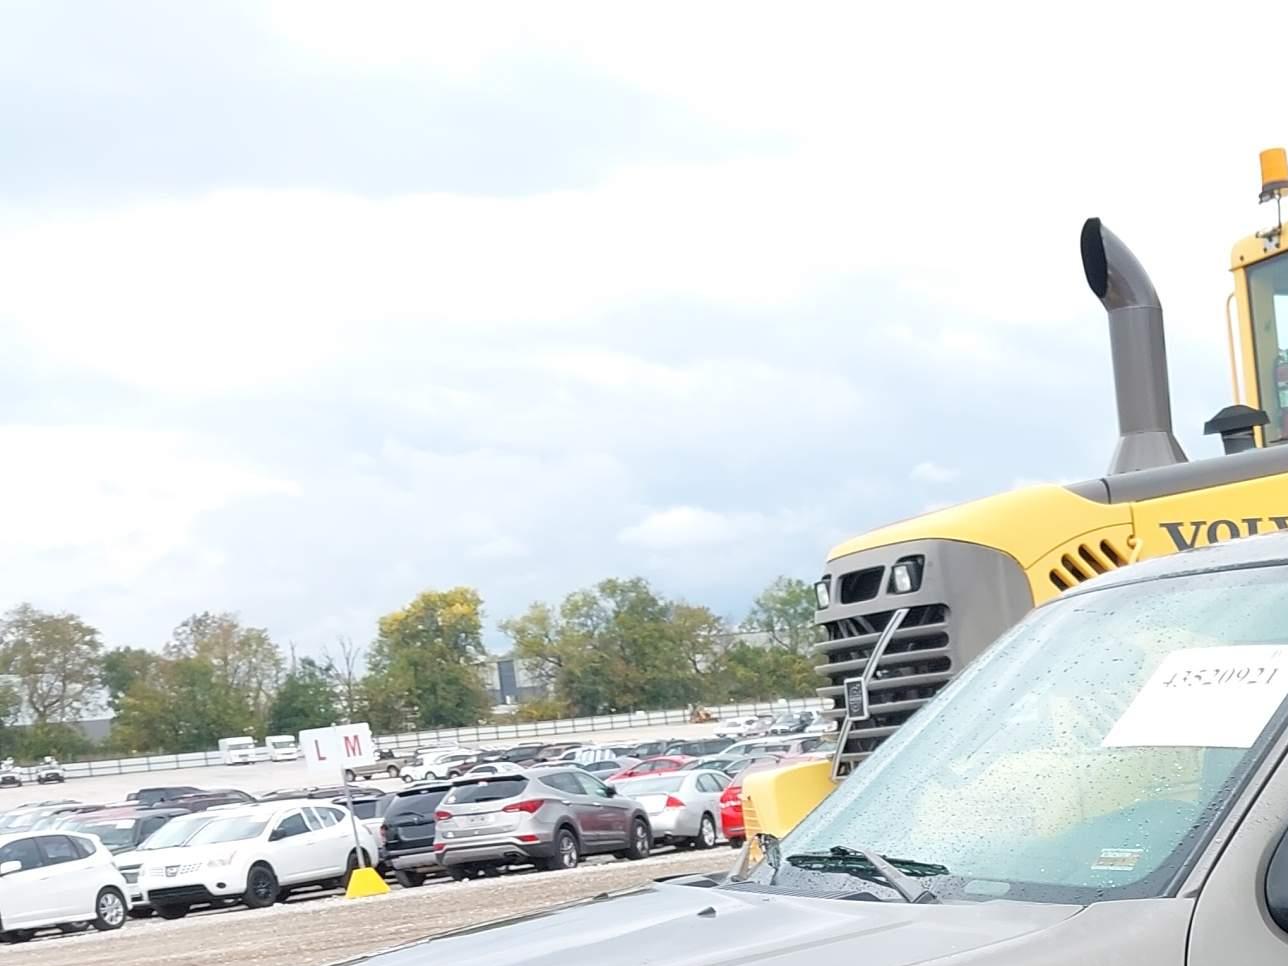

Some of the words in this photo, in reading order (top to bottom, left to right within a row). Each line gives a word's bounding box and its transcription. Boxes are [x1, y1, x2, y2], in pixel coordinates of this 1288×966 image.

[1163, 668, 1279, 687] 43520921
[314, 740, 327, 760] L
[344, 735, 362, 757] M
